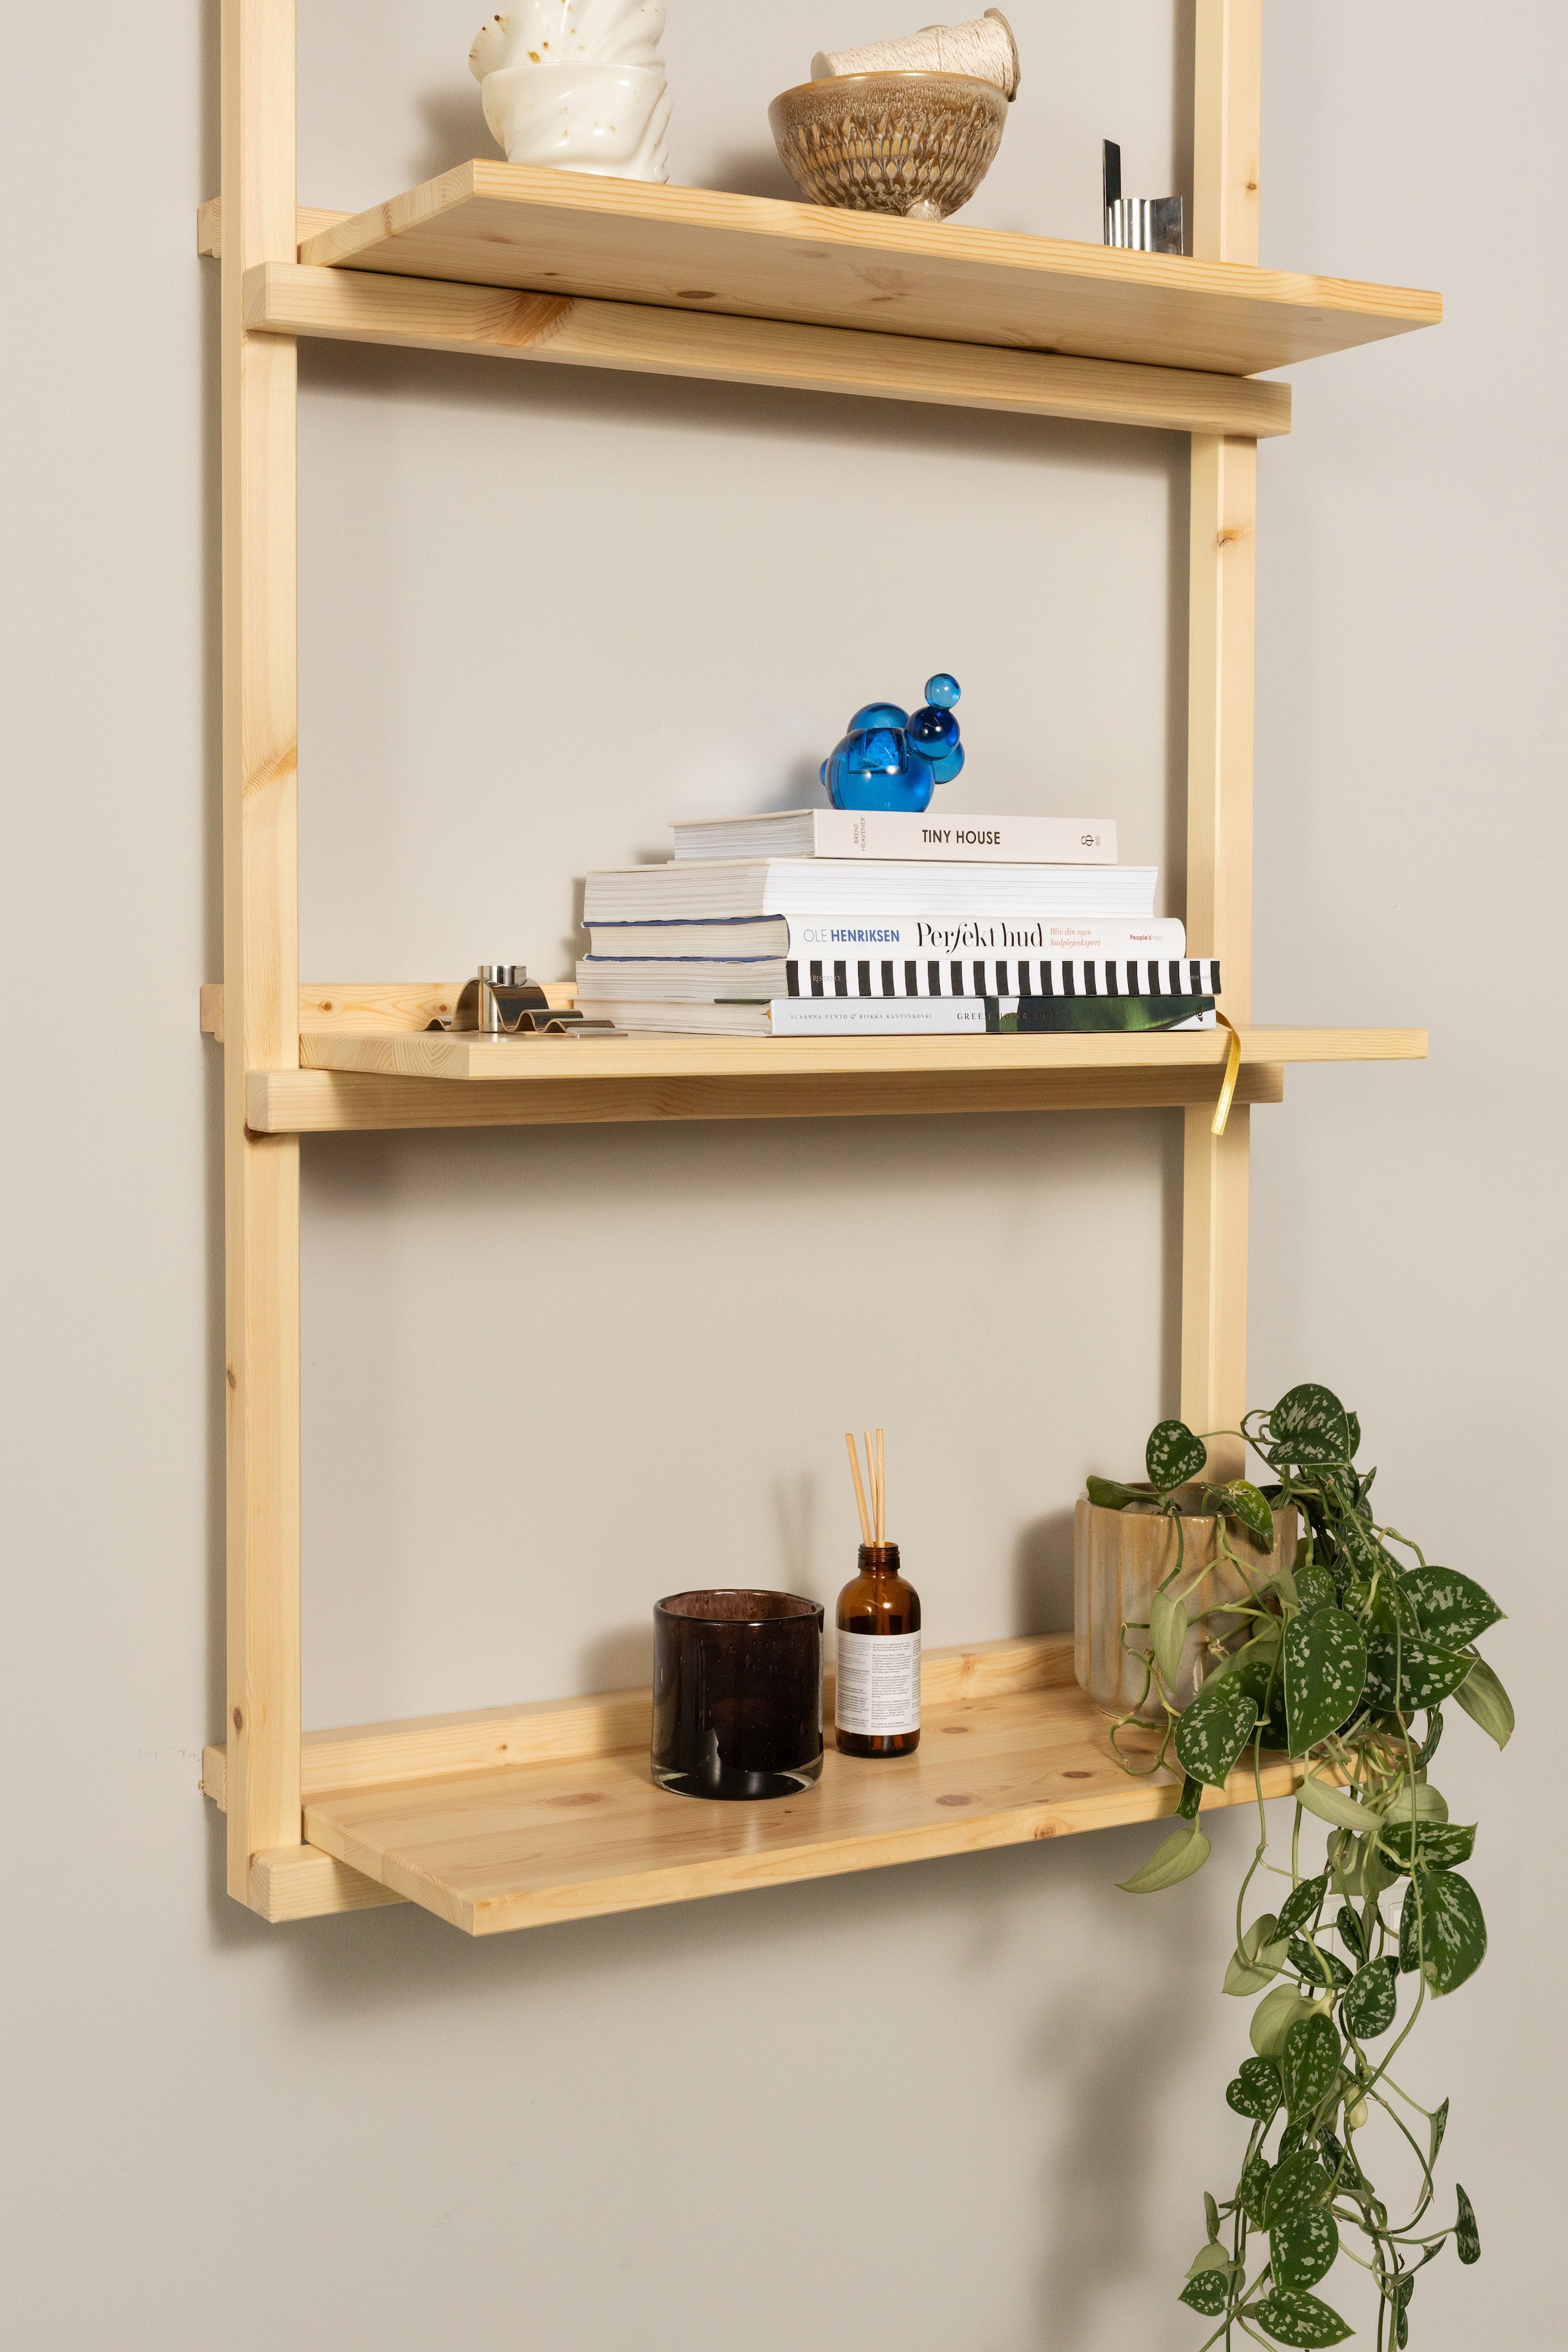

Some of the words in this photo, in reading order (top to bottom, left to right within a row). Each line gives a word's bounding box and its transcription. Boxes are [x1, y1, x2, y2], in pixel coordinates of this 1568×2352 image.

[922, 829, 951, 843] TINY
[956, 831, 1000, 845] HOUSE
[803, 929, 828, 942] OLE
[831, 929, 900, 942] HENRIKSEN
[914, 922, 998, 955] Perfekt
[999, 923, 1044, 947] hud
[1050, 938, 1101, 948] hudplejeekspert
